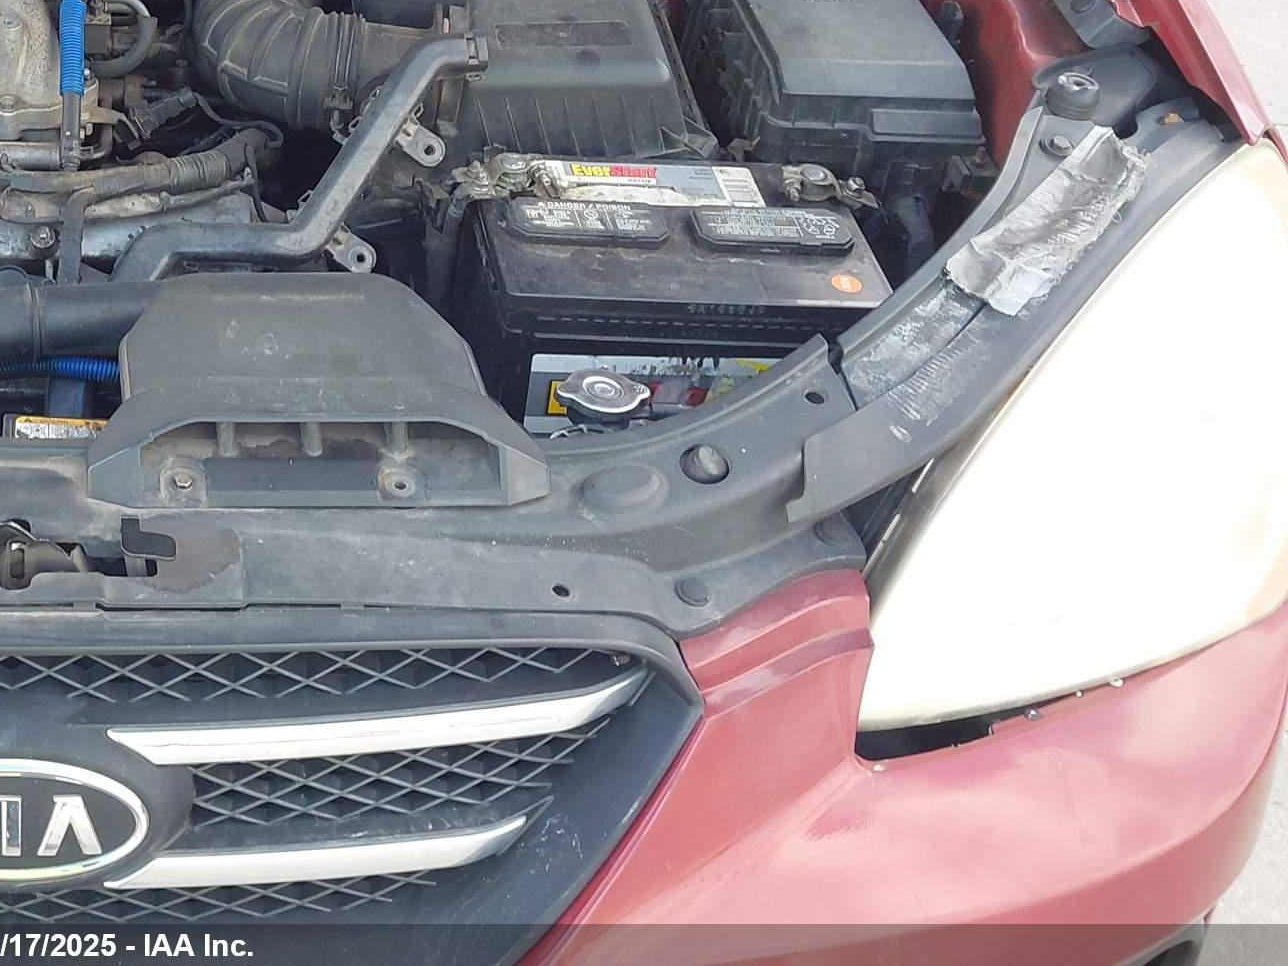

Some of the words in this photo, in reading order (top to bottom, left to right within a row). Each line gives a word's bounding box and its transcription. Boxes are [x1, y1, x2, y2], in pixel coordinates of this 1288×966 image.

[570, 163, 657, 178] EverStart
[547, 201, 586, 210] DANGER
[596, 203, 631, 211] POISON
